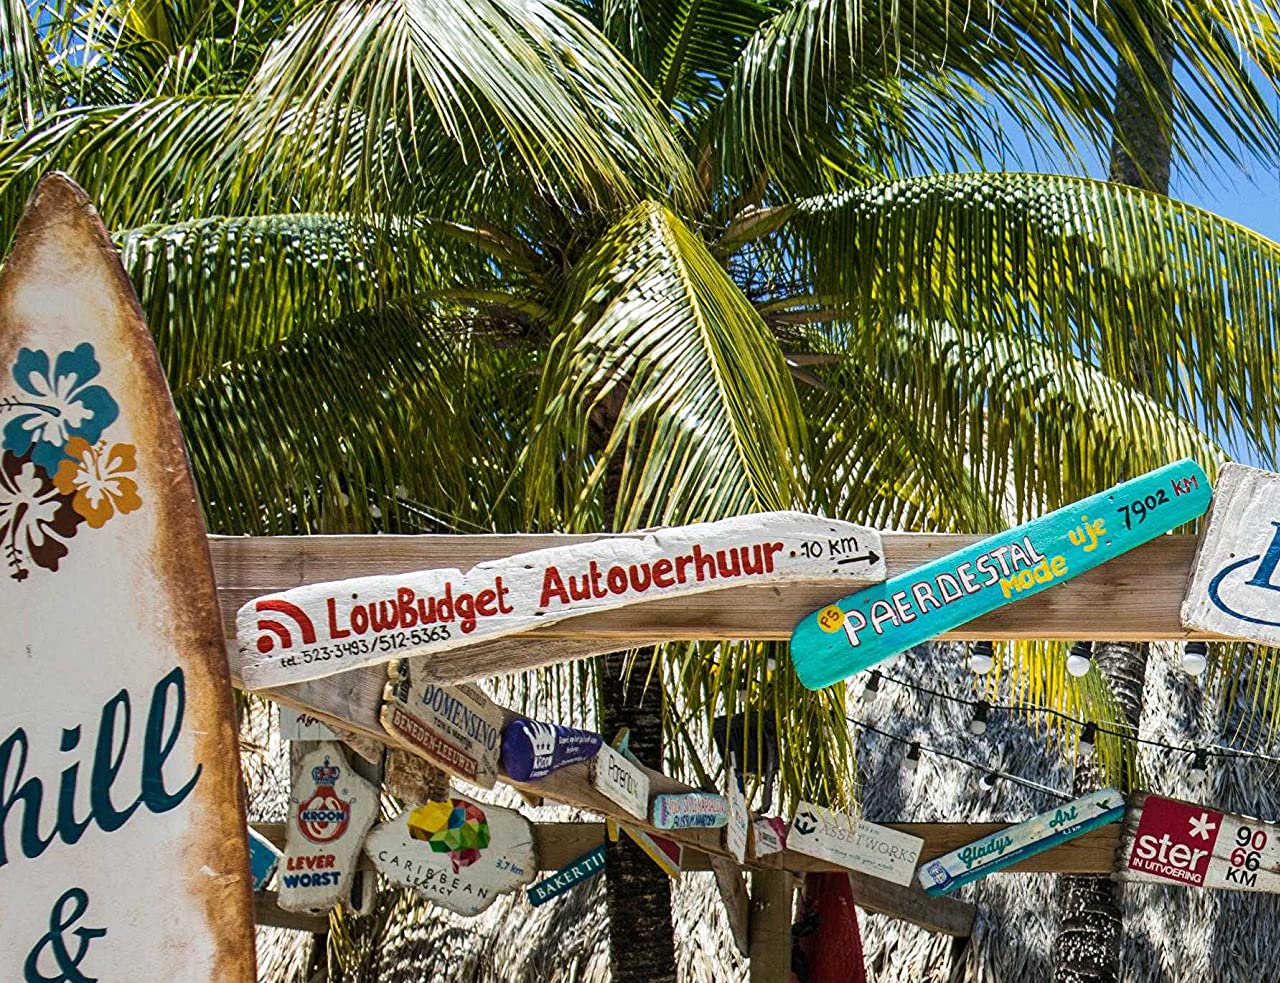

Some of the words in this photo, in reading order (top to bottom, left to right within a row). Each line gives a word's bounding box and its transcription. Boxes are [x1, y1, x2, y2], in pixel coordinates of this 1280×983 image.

[1117, 489, 1170, 530] 7902
[829, 535, 859, 556] km
[327, 576, 514, 640] LowBudget
[539, 541, 784, 607] Autoverhuur
[842, 536, 1046, 648] PAERDESTAL
[820, 609, 840, 630] PS
[303, 624, 452, 665] 523-3493/512-5363
[0, 666, 203, 867] hill
[302, 810, 346, 822] KROON
[958, 834, 1014, 868] Gladys
[1049, 805, 1079, 828] Art
[1235, 826, 1267, 852] 90
[286, 854, 336, 872] LEVER
[1136, 833, 1209, 871] ster
[1230, 847, 1262, 872] 66
[283, 871, 342, 889] WORST
[378, 850, 489, 899] CARIBBEAN
[536, 866, 584, 900] BAKER
[1132, 857, 1143, 868] IN
[1145, 860, 1202, 883] UITVOERING
[1226, 866, 1258, 888] KM
[405, 874, 453, 896] LEGACY
